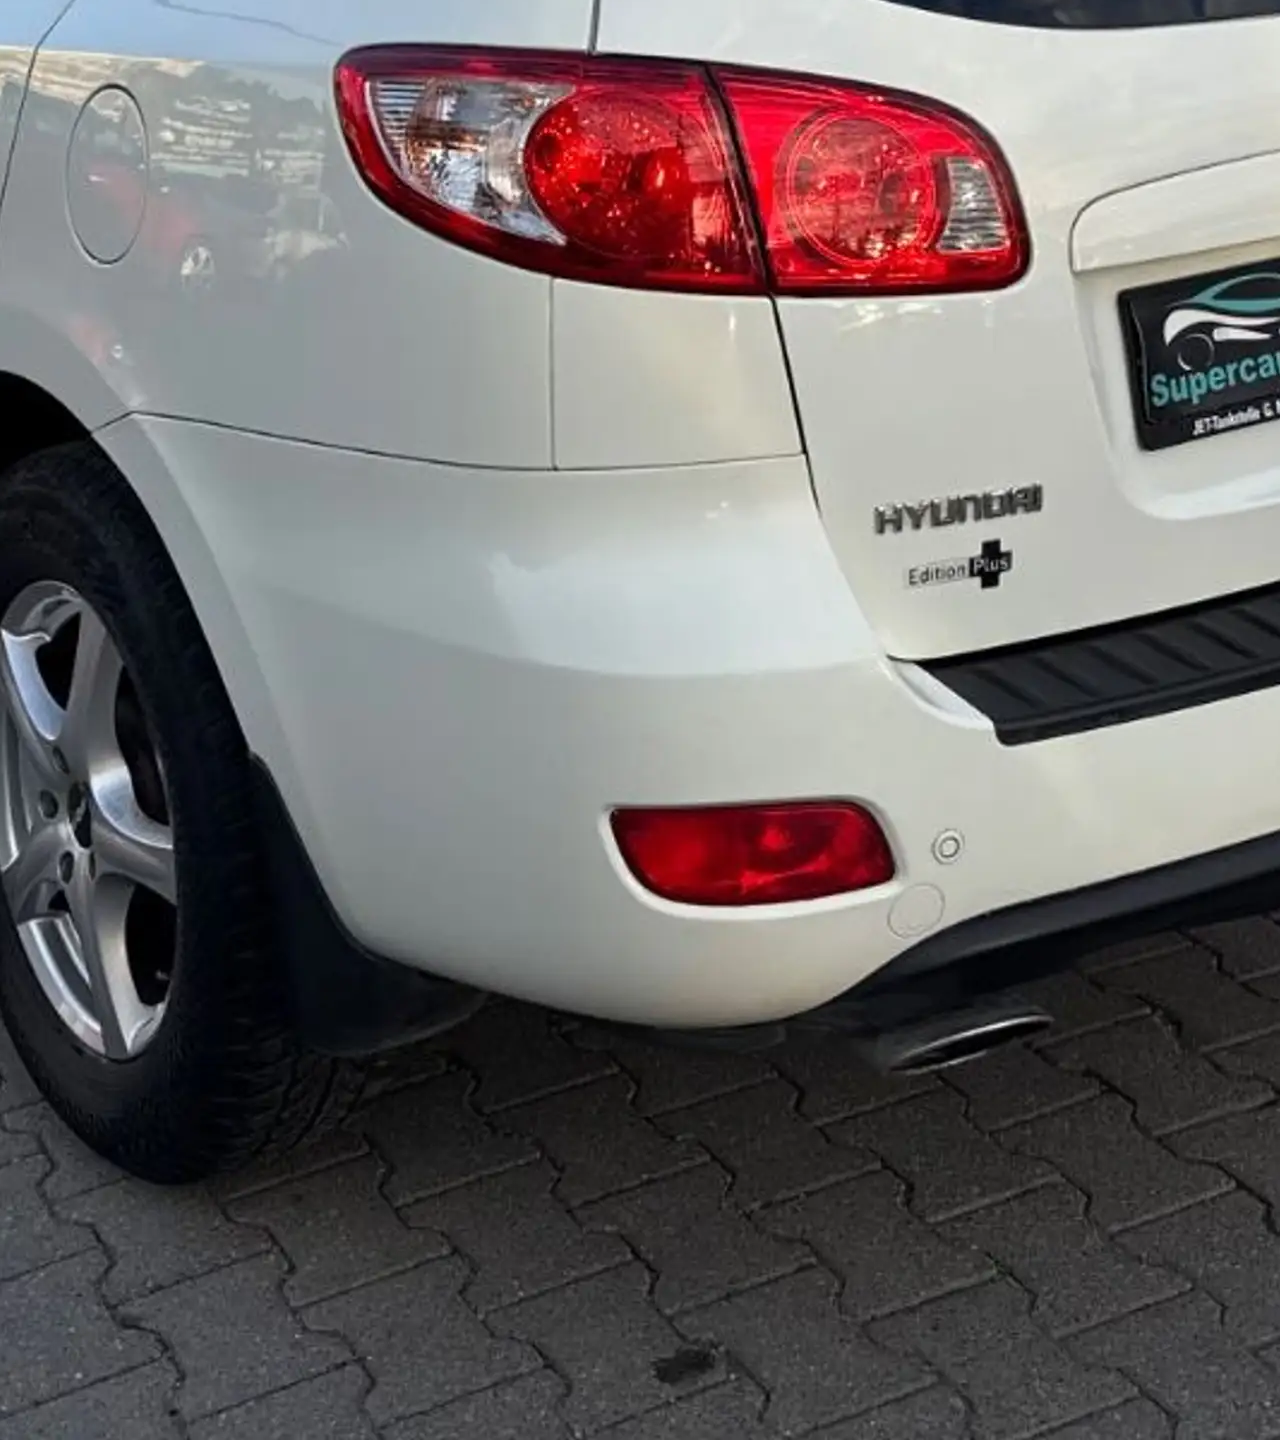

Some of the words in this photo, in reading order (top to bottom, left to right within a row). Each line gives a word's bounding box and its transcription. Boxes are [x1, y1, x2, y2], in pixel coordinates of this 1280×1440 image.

[874, 481, 1043, 535] HYUNDAI
[908, 561, 966, 586] Edition
[973, 556, 1010, 573] Plus
